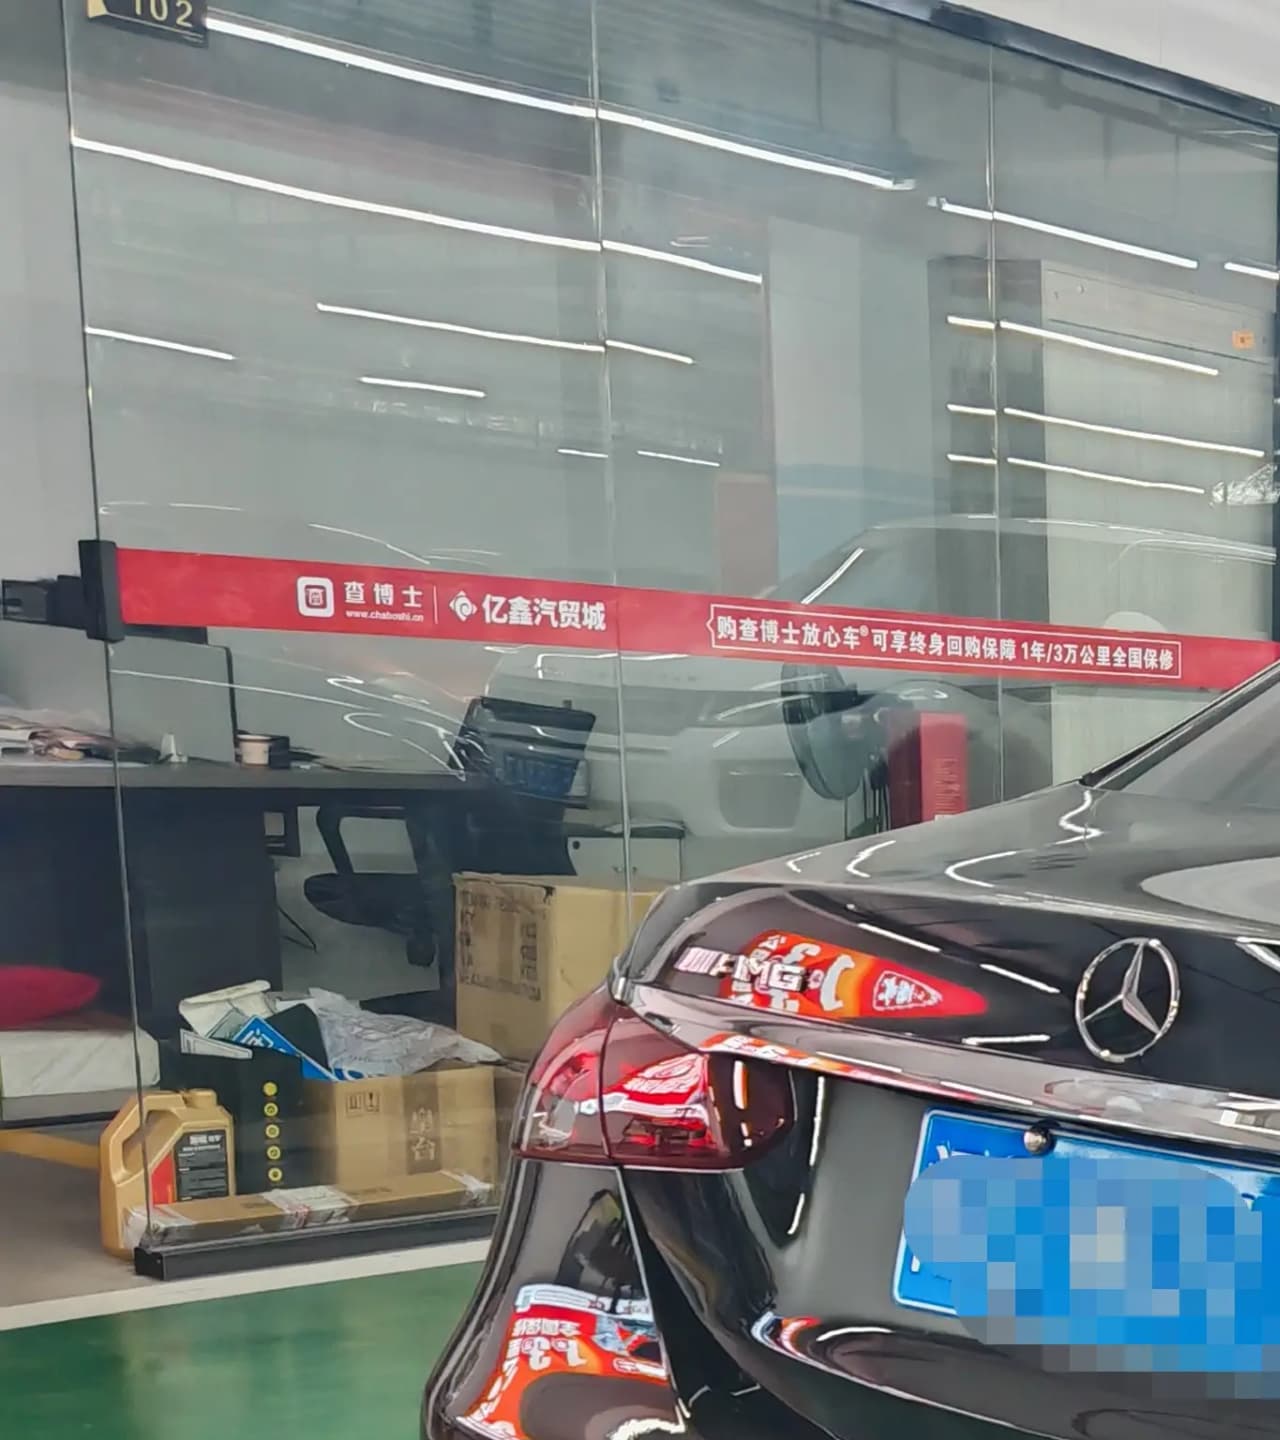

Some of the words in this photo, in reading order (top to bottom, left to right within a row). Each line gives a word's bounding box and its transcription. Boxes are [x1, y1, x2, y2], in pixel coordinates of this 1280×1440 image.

[343, 581, 424, 609] 查博士
[482, 593, 607, 631] 亿鑫汽贸城
[1021, 640, 1175, 671] 1年/3万公里全国保修
